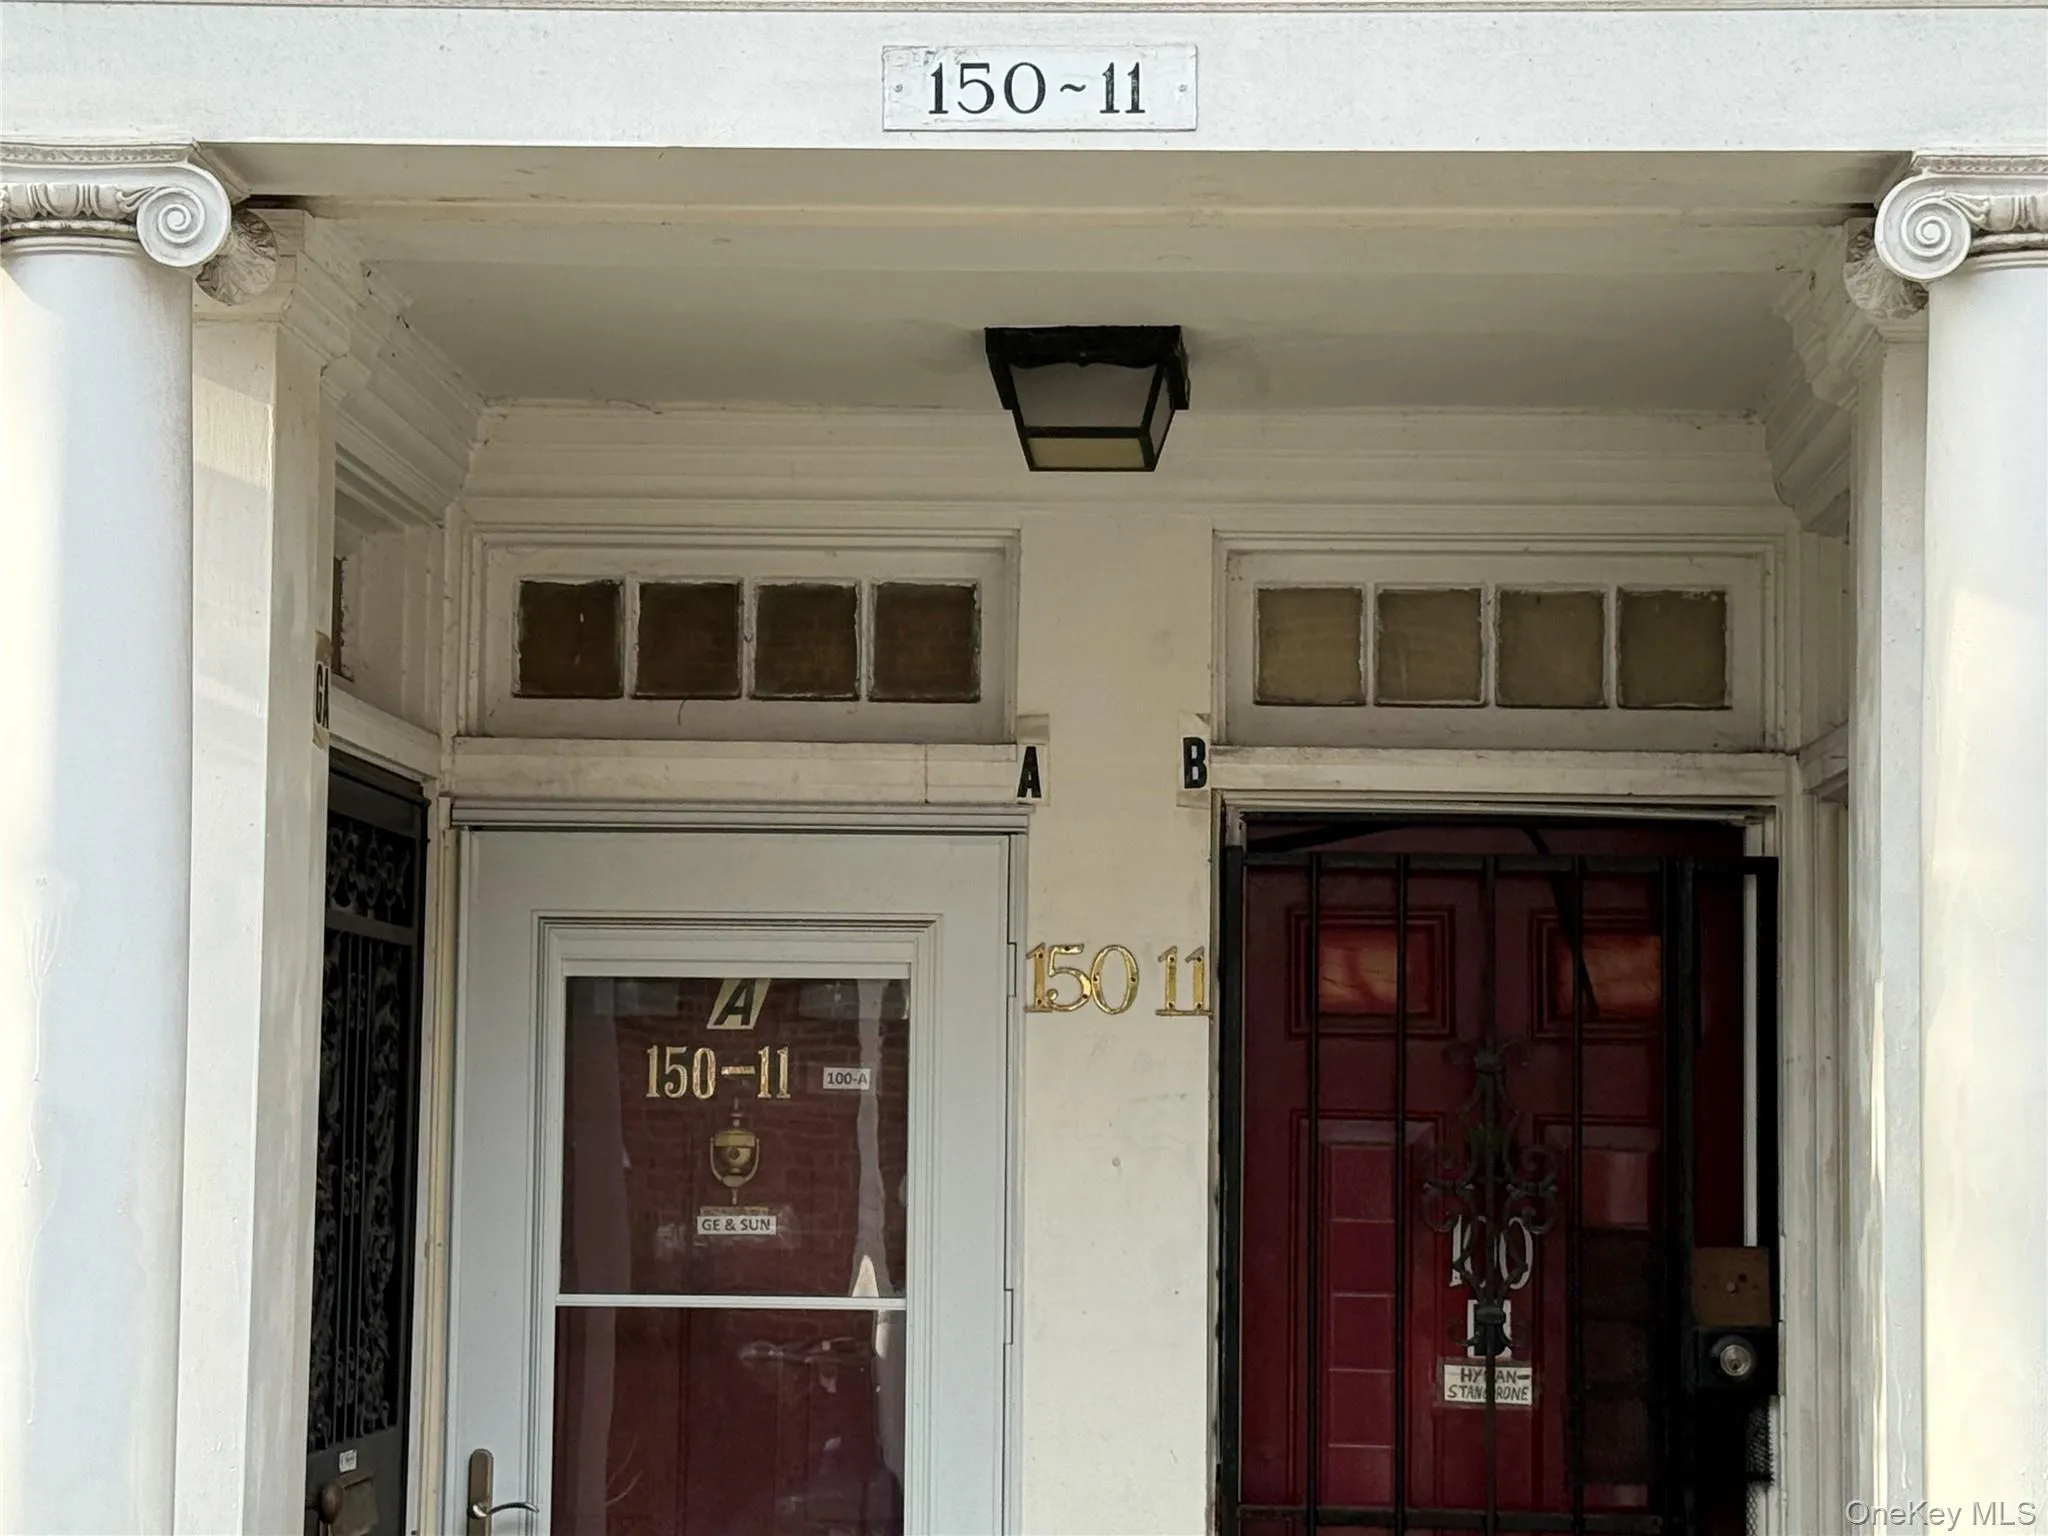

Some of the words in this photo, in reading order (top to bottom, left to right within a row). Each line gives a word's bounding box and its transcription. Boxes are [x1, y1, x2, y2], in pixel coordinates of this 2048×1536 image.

[1016, 745, 1043, 799] A
[1182, 736, 1208, 790] B
[714, 979, 757, 1027] A
[1024, 942, 1140, 1016] 150
[1155, 945, 1213, 1017] 11
[645, 1044, 792, 1100] 150-11
[826, 1071, 868, 1086] 100-A
[701, 1218, 721, 1232] GE
[724, 1218, 737, 1232] &
[740, 1218, 771, 1232] SUN
[1460, 1366, 1530, 1385] HYAN-
